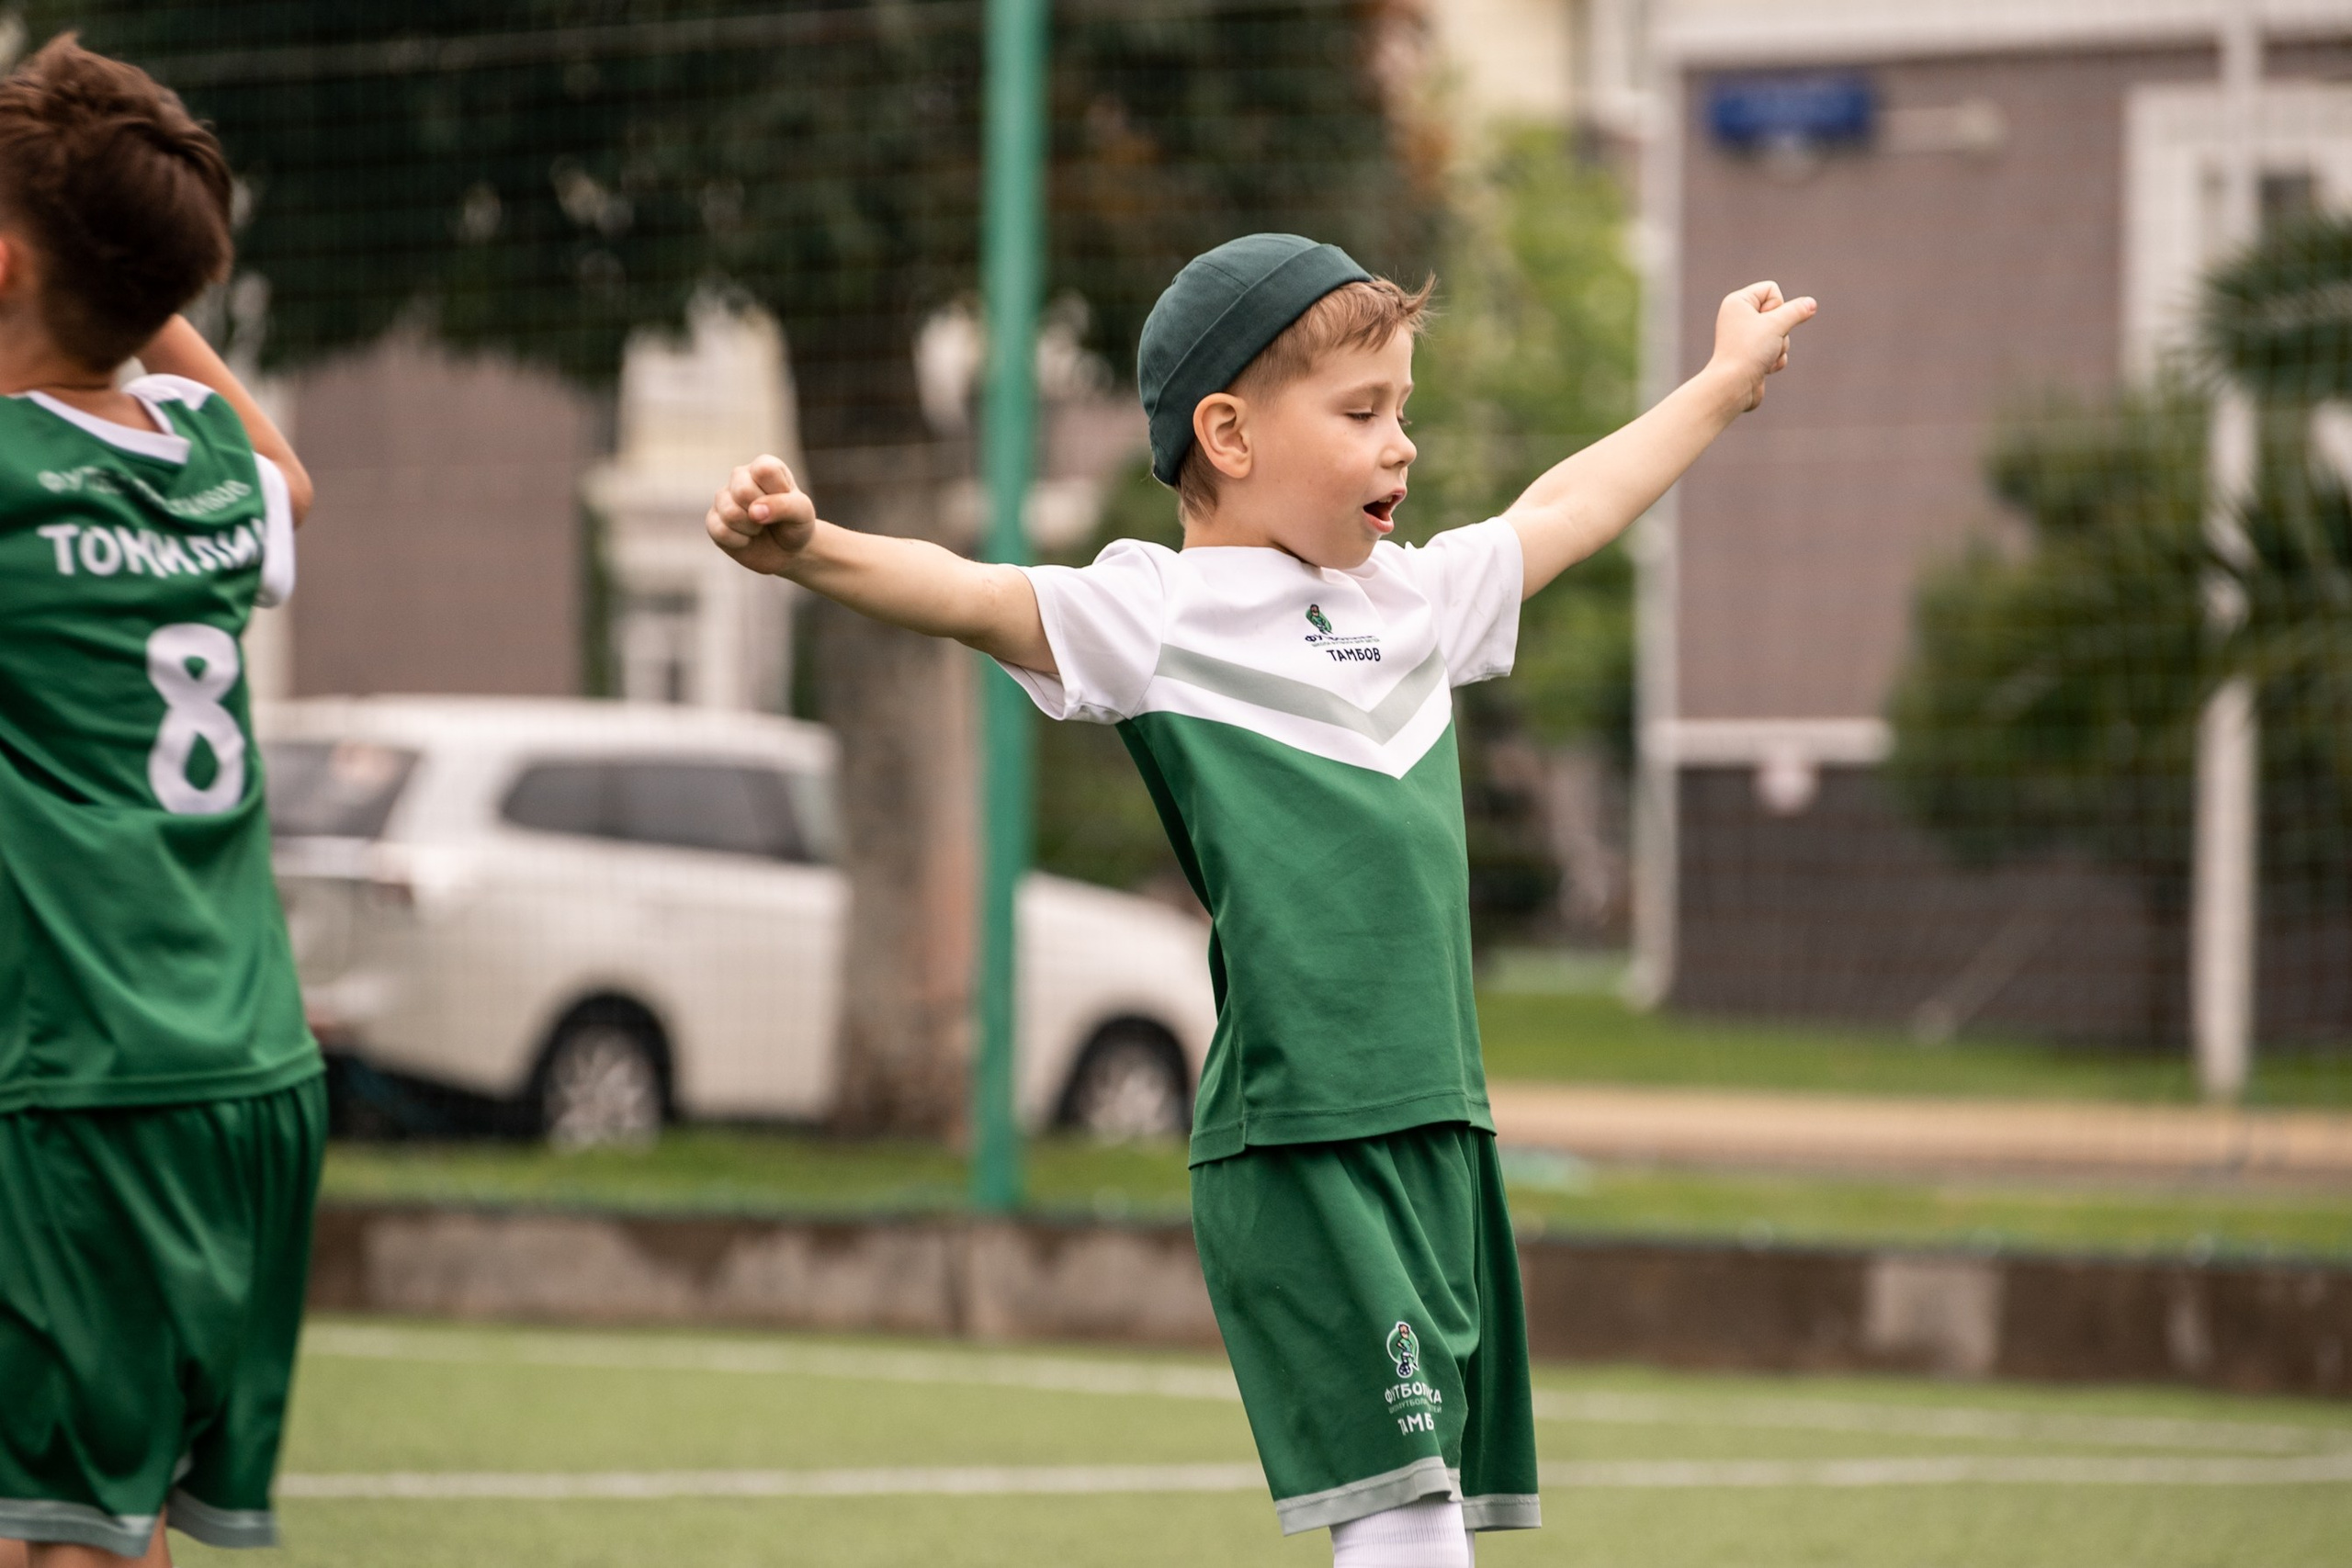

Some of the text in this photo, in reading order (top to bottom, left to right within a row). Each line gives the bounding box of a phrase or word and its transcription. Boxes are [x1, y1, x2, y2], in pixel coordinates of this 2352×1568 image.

[1326, 648, 1381, 661] ТАМБОВ
[146, 622, 245, 815] 8
[1397, 1412, 1434, 1436] ТАМБ
